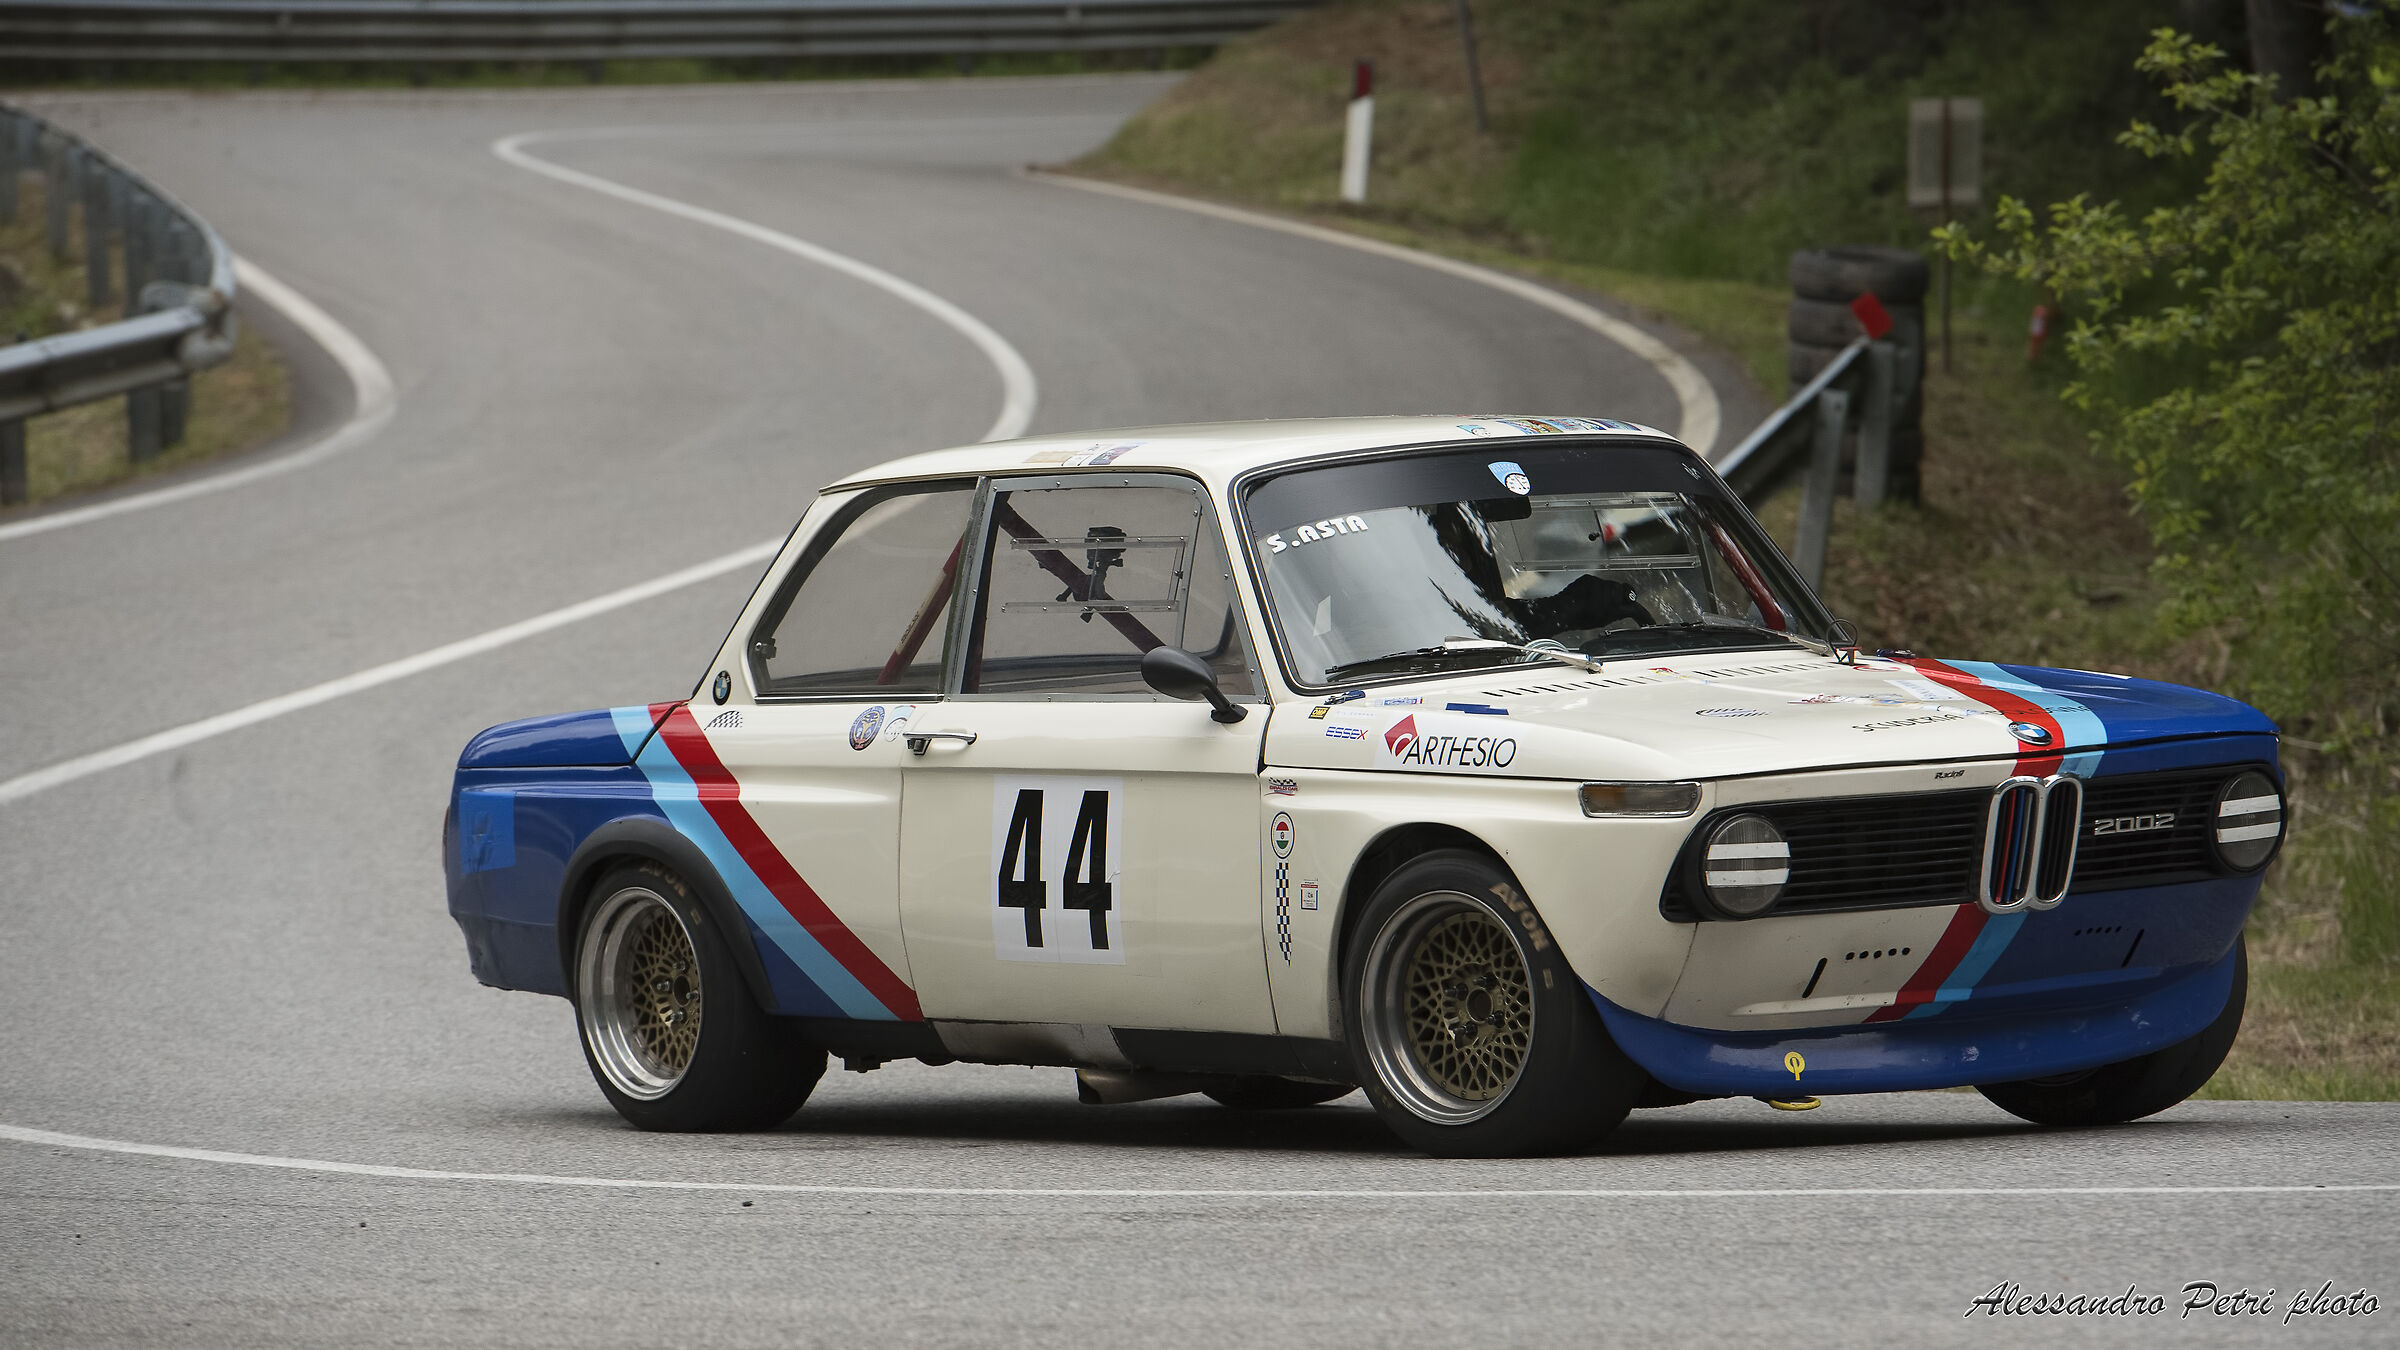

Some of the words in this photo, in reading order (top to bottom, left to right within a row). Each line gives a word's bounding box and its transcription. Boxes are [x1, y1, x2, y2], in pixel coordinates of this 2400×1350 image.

[1852, 714, 1964, 732] SCUDERIA
[2094, 812, 2175, 836] 2002
[998, 789, 1113, 950] 44
[1488, 881, 1551, 953] AVON
